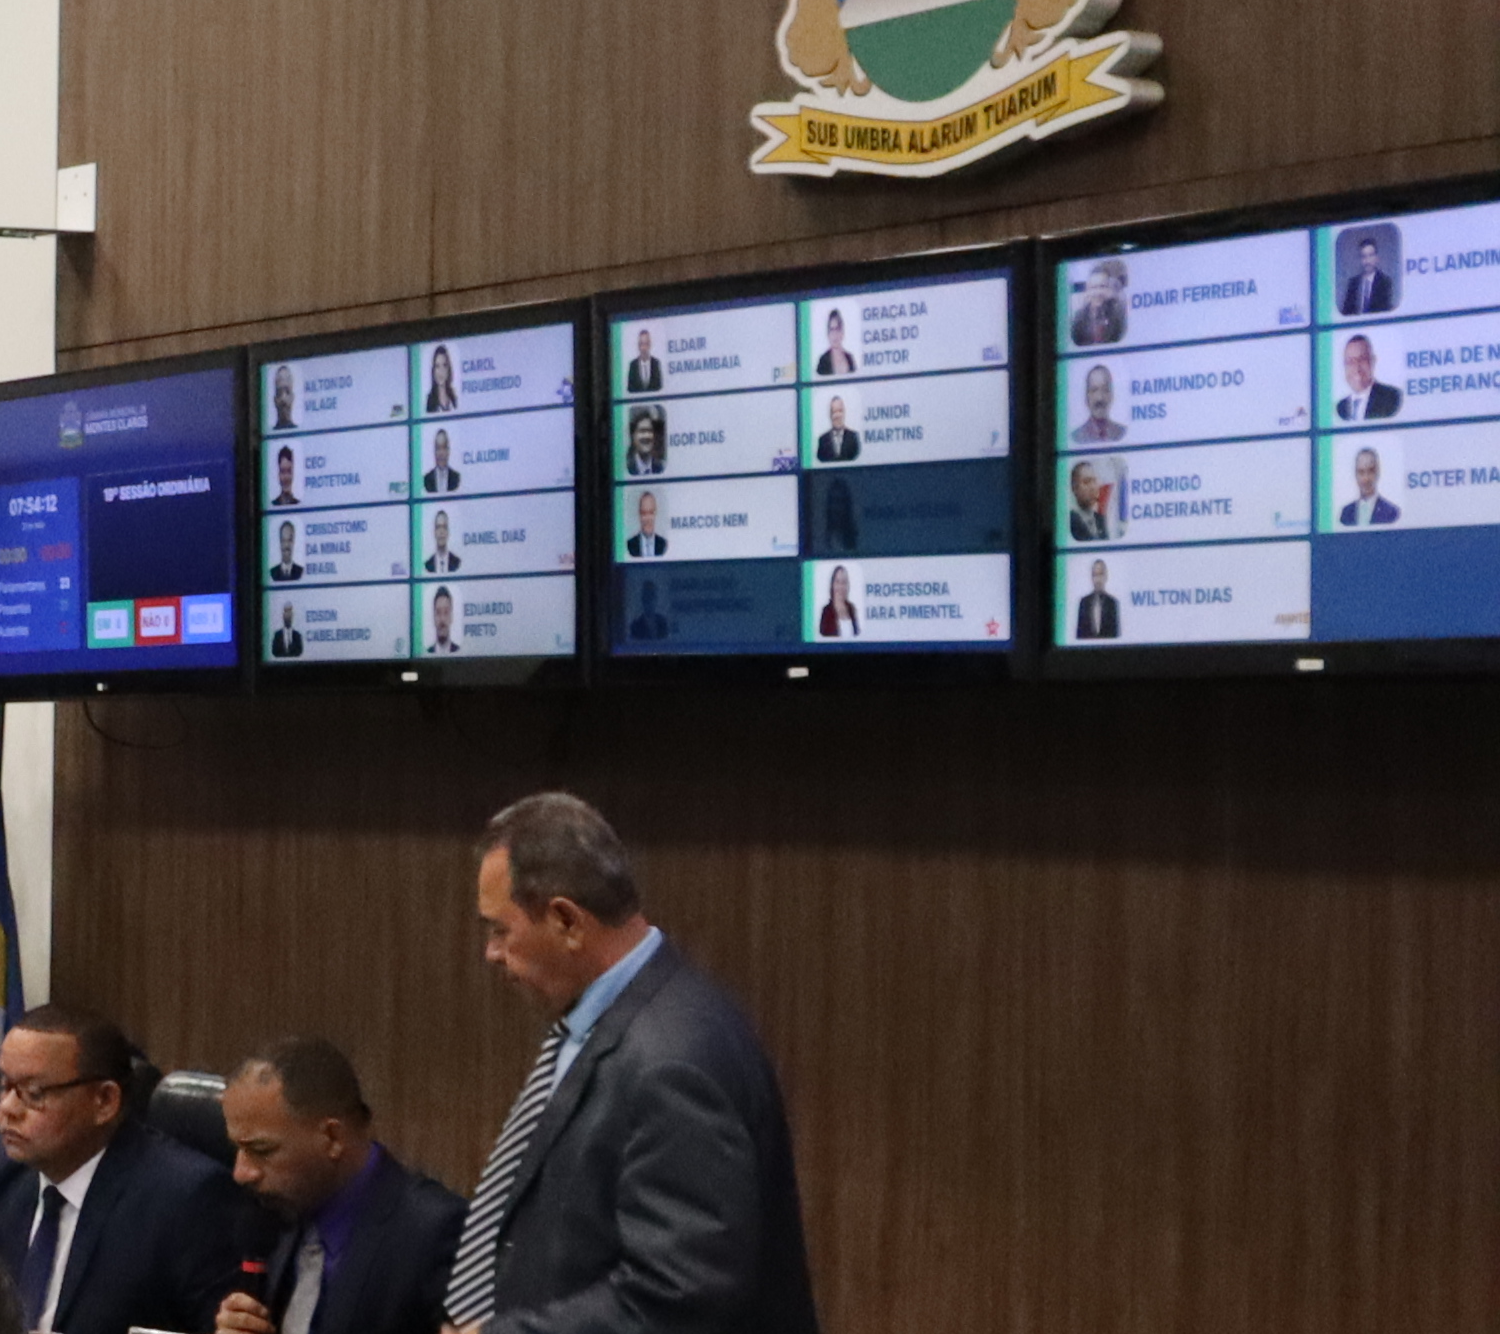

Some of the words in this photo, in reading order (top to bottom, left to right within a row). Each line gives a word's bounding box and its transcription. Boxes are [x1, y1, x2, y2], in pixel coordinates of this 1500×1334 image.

[806, 120, 839, 148] SUB
[844, 124, 902, 154] UMBRA
[909, 116, 978, 154] ALARUM
[983, 71, 1058, 132] TUARUM
[1406, 257, 1429, 275] PC
[1131, 289, 1179, 309] ODAIR
[1181, 279, 1258, 304] FERREIRA
[862, 303, 907, 323] GRAÇA
[909, 301, 928, 318] DA
[863, 327, 896, 345] CASA
[900, 325, 920, 342] DO
[667, 337, 707, 354] ELDAIR
[863, 349, 910, 367] MOTOR
[1406, 348, 1456, 368] RENA
[1460, 344, 1484, 364] DE
[1131, 373, 1218, 395] RAIMUNDO
[1220, 370, 1245, 388] DO
[864, 404, 911, 422] JUNIOR
[1131, 403, 1167, 422] INSS
[669, 432, 697, 448] IGOR
[698, 430, 726, 446] DIAS
[864, 425, 924, 444] MARTINS
[1131, 474, 1202, 495] RODRIGO
[1407, 468, 1465, 490] SOTER
[1131, 498, 1233, 520] CADEIRANTE
[670, 514, 721, 530] MARCOS
[722, 513, 749, 528] NEM
[865, 581, 950, 598] PROFESSORA
[1130, 588, 1192, 607] WILTON
[1195, 587, 1233, 605] DIAS
[866, 605, 897, 621] IARA
[899, 603, 963, 620] PIMENTEL
